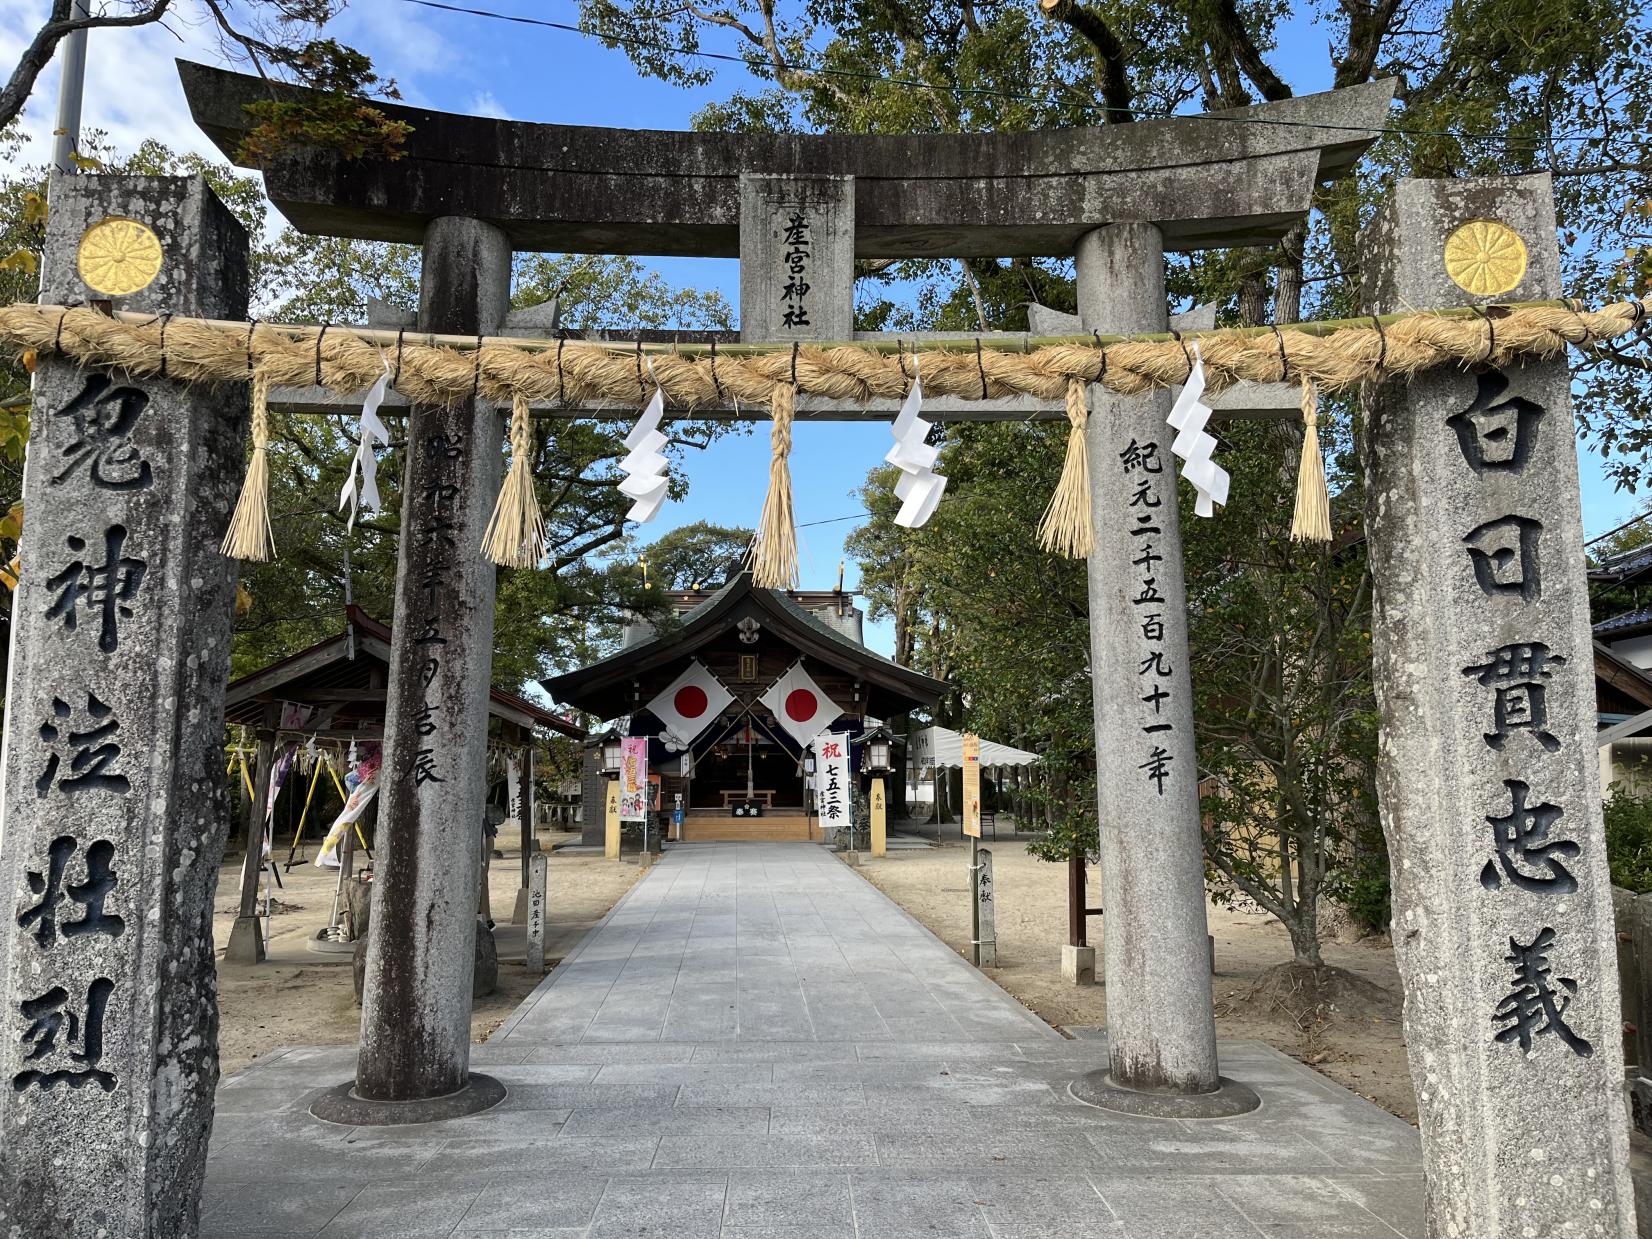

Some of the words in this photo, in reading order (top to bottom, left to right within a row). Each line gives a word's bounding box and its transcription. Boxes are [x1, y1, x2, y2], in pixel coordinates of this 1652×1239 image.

[780, 212, 811, 330] 産宮神社
[13, 373, 153, 1092] 鬼神泣壮烈
[1119, 438, 1174, 796] 紀元二千五百九十一年
[1446, 371, 1595, 1059] 白日貫忠義
[822, 742, 842, 760] 祝
[826, 764, 842, 820] 七五三祭
